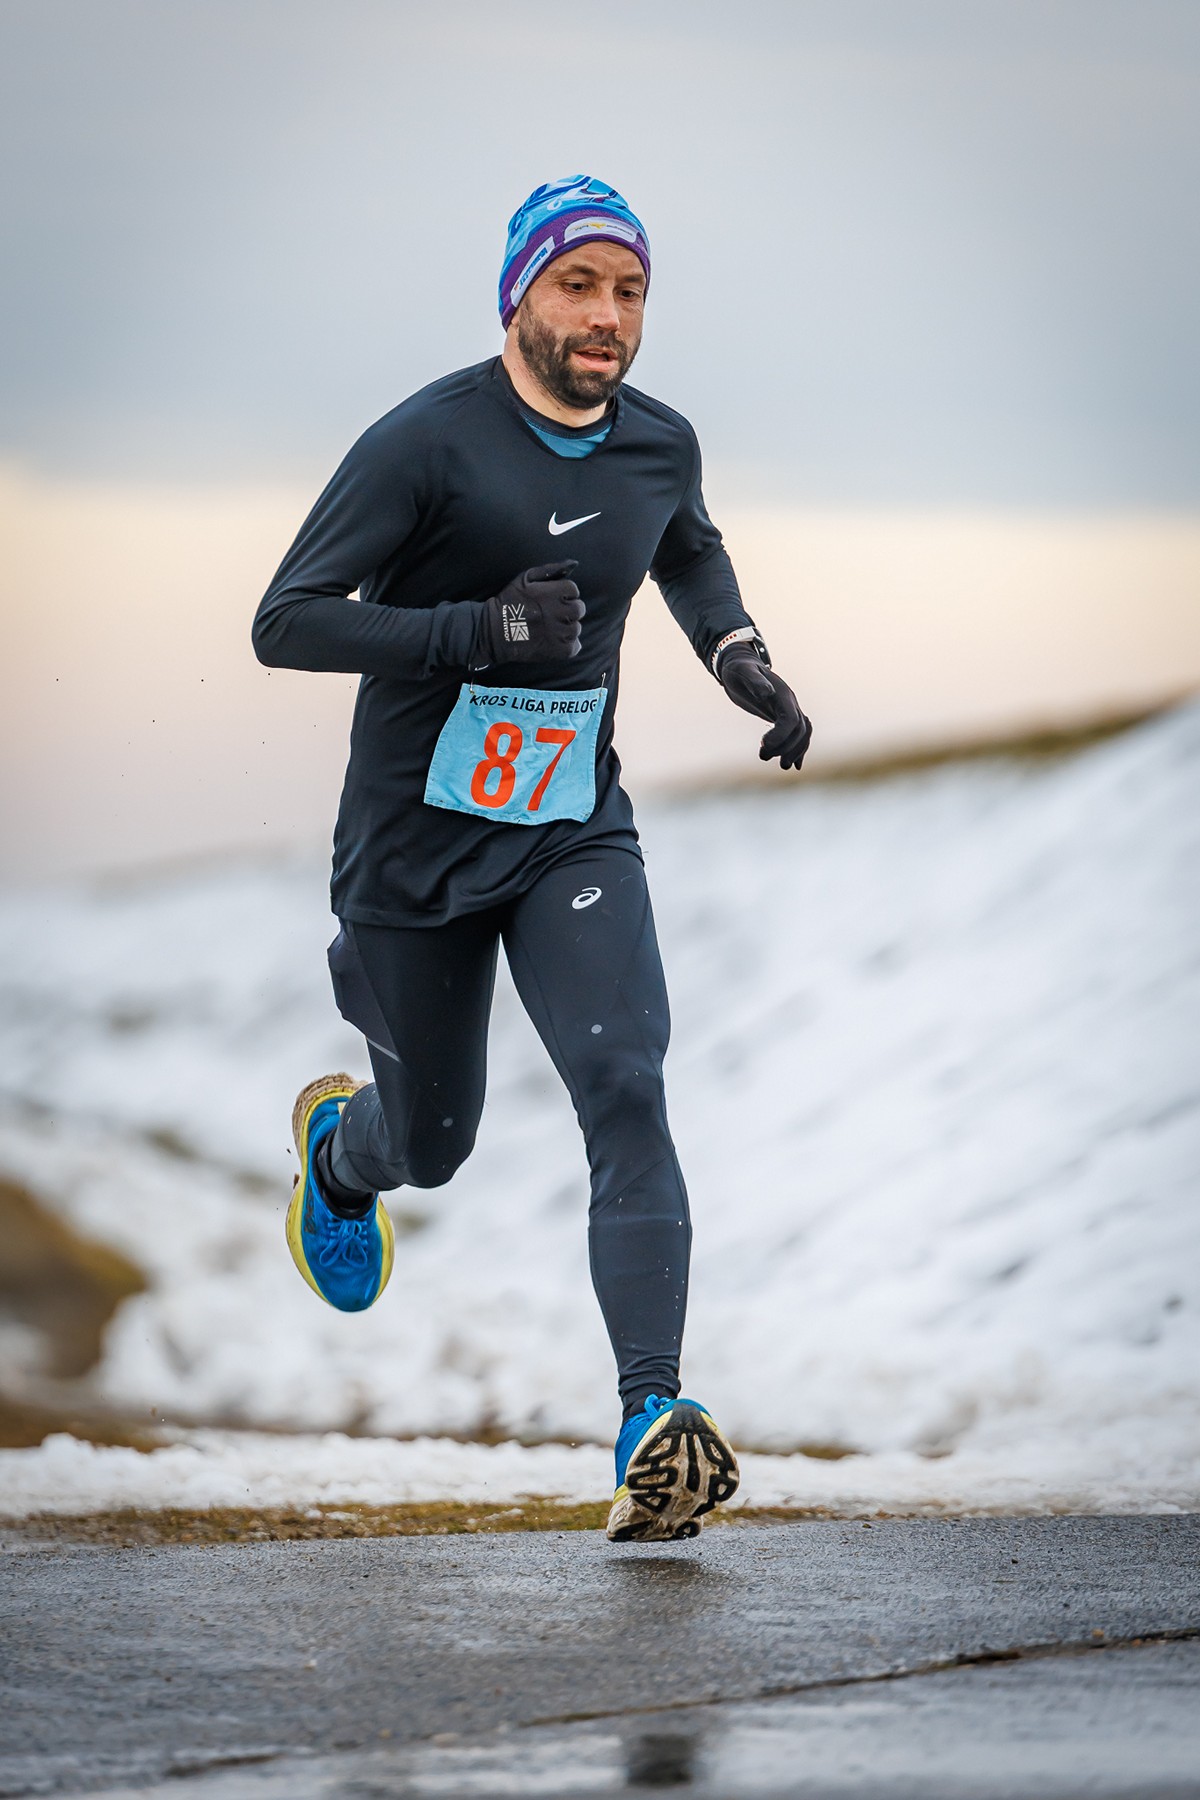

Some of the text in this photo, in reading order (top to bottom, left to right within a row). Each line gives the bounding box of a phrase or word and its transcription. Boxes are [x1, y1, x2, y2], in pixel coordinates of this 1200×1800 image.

[502, 604, 510, 642] karrimor
[469, 695, 509, 707] KROS
[511, 697, 545, 713] LIGA
[470, 721, 577, 811] 87
